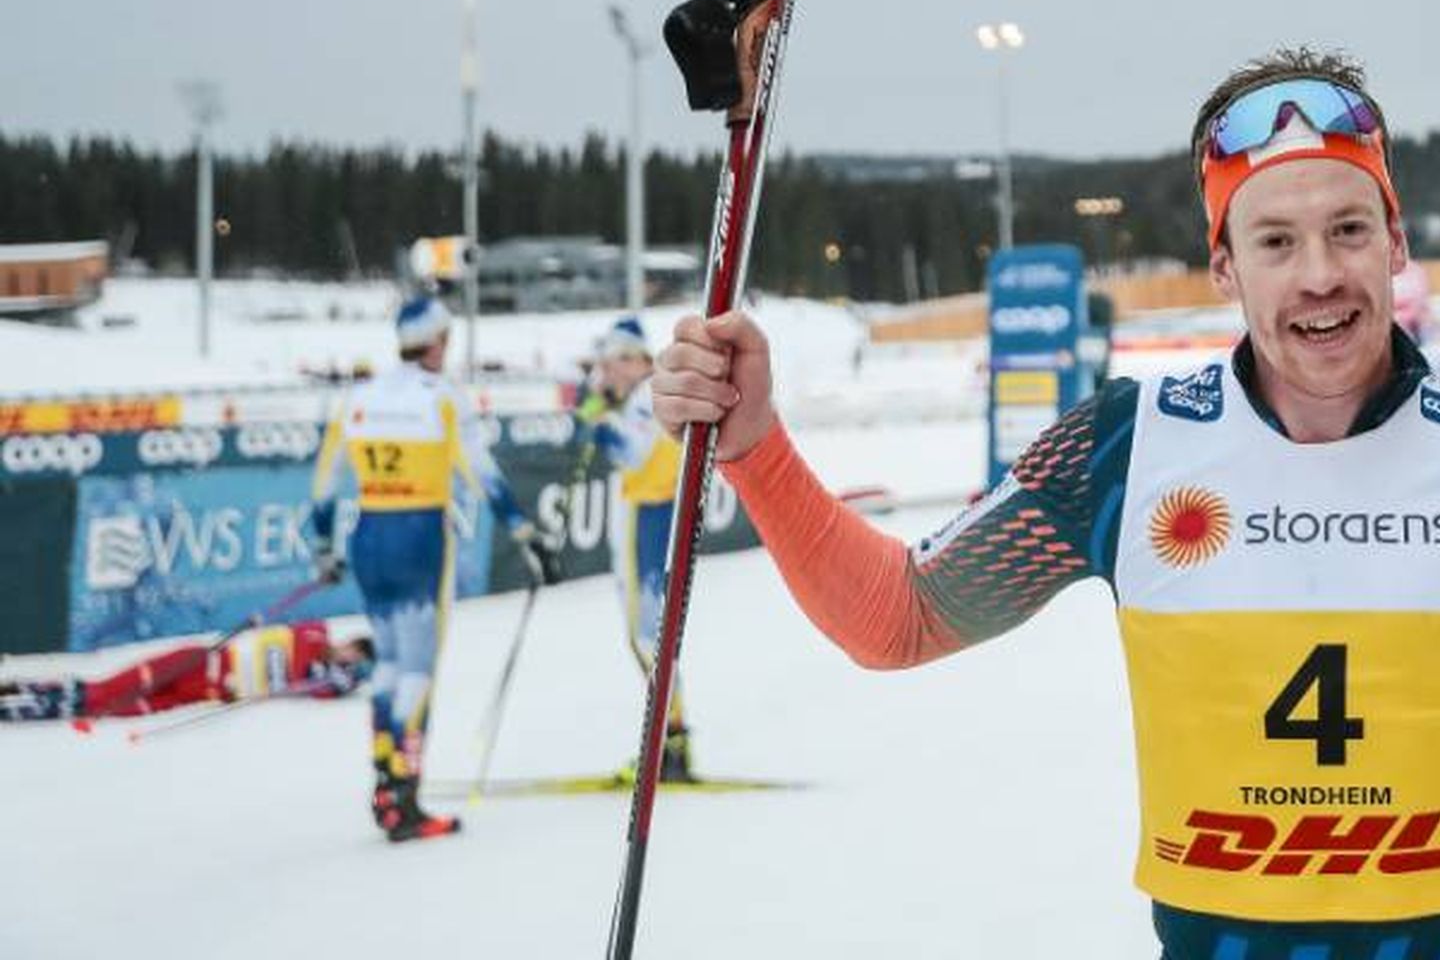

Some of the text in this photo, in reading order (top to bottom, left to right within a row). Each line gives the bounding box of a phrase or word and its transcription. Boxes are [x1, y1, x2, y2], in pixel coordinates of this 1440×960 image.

[364, 444, 403, 474] 12
[1264, 643, 1364, 767] 4
[1239, 785, 1393, 807] TRONDHEIM
